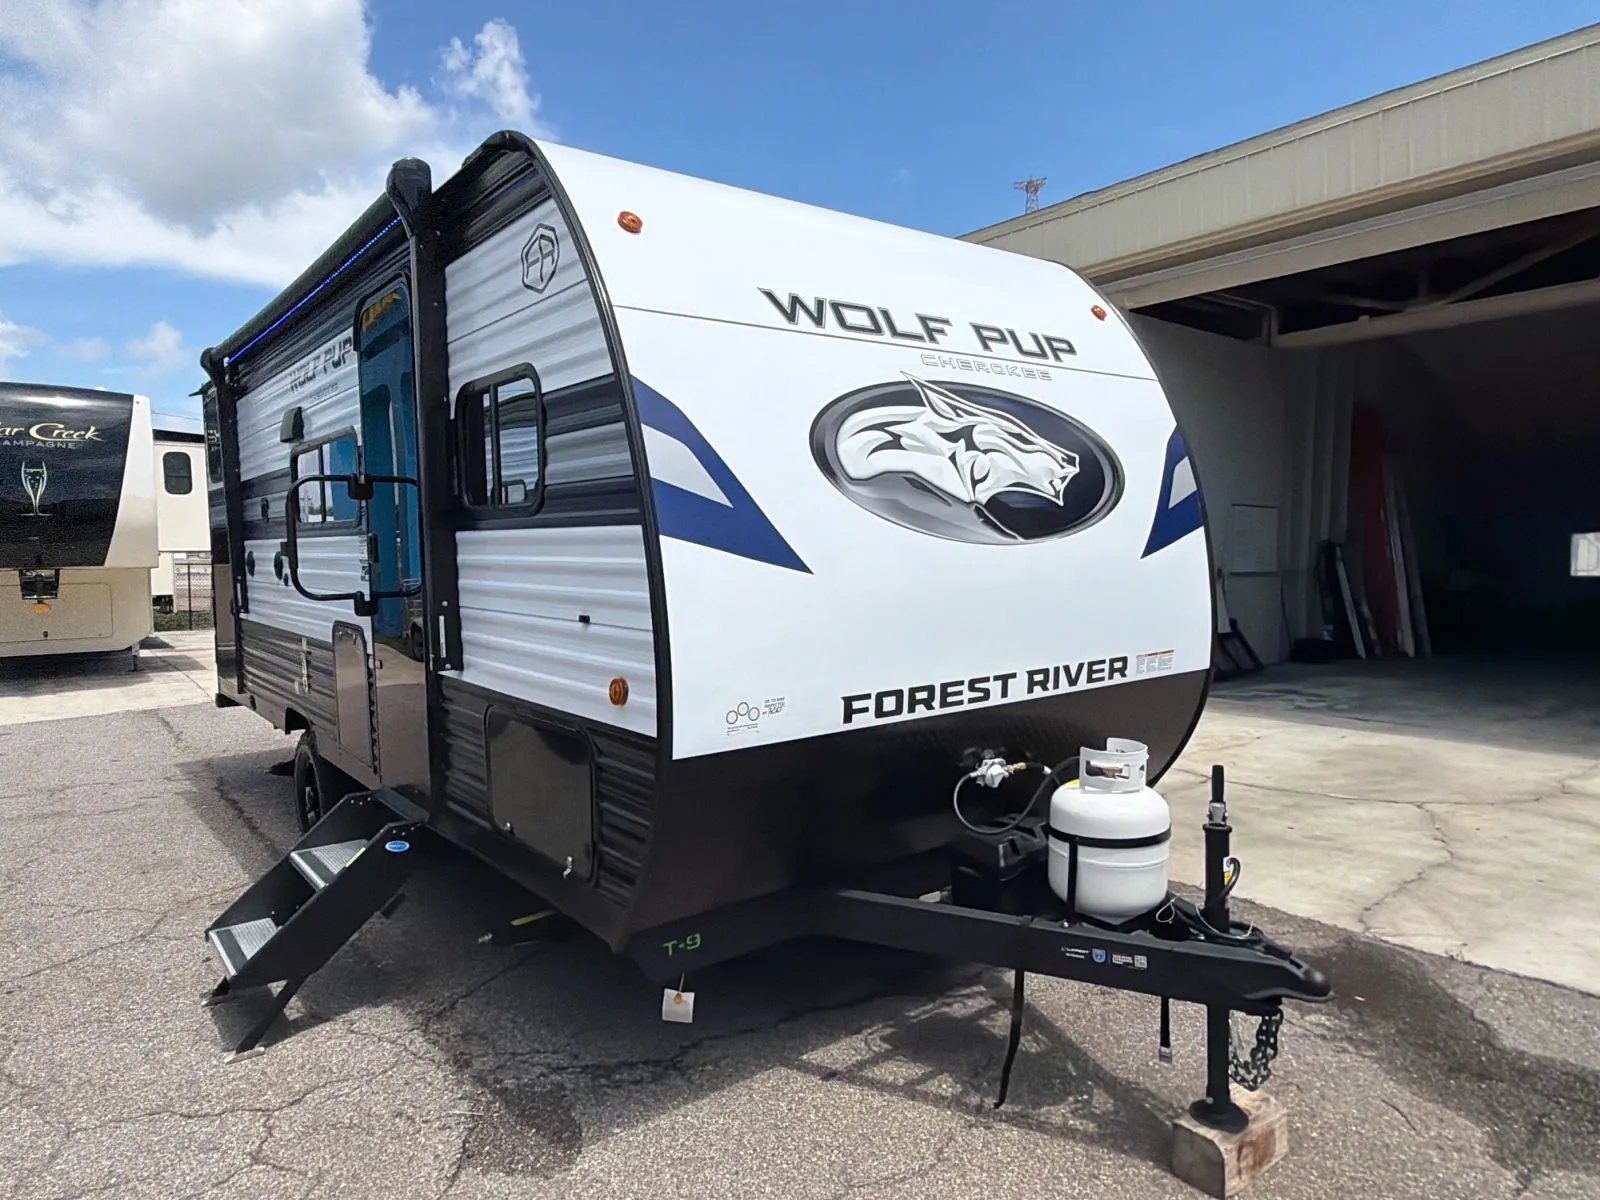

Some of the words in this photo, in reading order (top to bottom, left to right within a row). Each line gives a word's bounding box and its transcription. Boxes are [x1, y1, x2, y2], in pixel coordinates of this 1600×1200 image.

[757, 287, 952, 343] WOLF
[968, 321, 1077, 362] PUP
[323, 336, 353, 374] PUP
[920, 353, 1052, 380] CHEROKEE
[29, 422, 105, 441] Creek
[840, 672, 1017, 724] FOREST
[1026, 656, 1128, 694] RIVER
[663, 933, 701, 956] T-9
